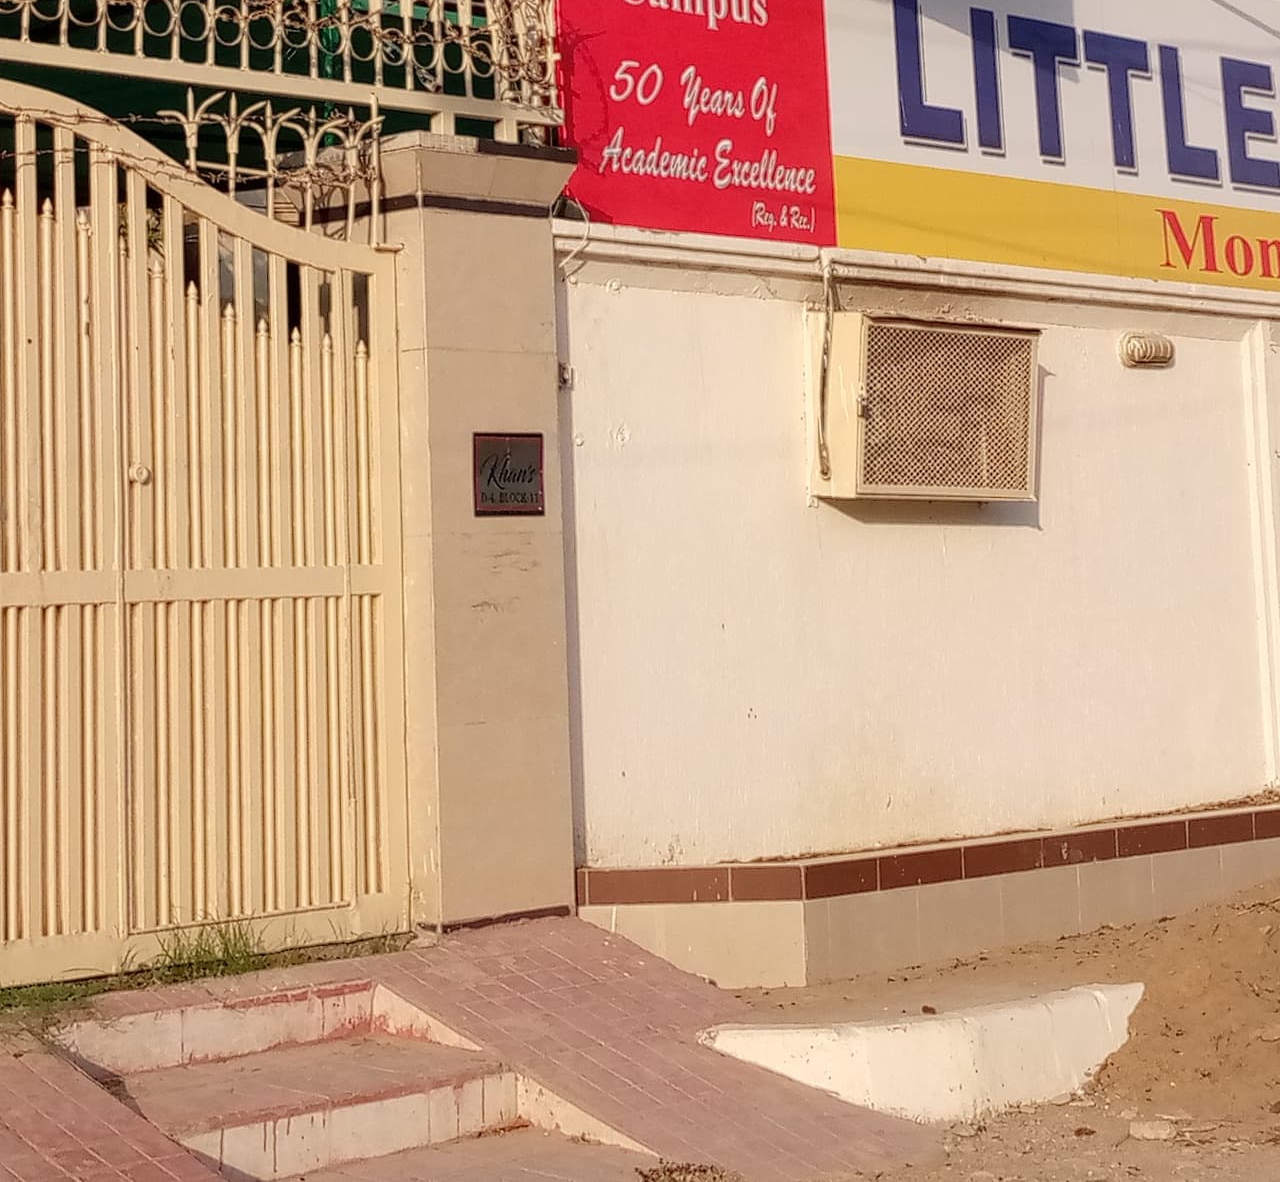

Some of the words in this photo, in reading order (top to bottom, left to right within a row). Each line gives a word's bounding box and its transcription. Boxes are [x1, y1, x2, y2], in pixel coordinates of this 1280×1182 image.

[609, 59, 663, 106] 50
[680, 65, 745, 125] Years
[751, 76, 778, 136] Of
[599, 126, 708, 182] Academic
[712, 139, 817, 194] Excellence
